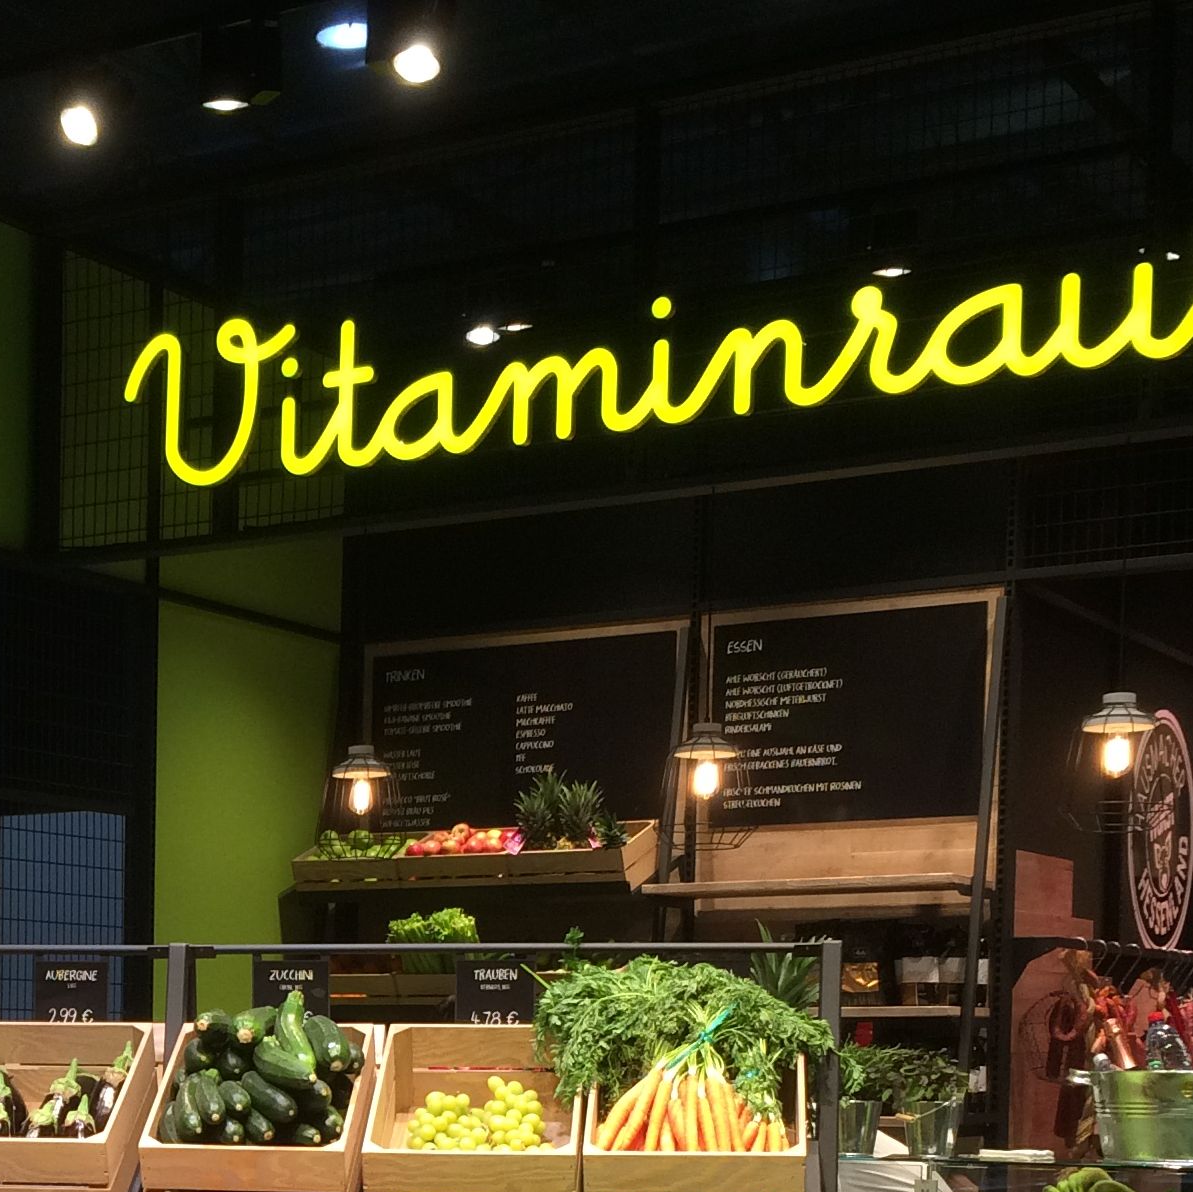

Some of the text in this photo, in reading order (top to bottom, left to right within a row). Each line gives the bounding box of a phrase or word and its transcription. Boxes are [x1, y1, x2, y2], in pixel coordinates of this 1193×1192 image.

[726, 639, 763, 655] ESSEN
[516, 693, 537, 702] KAFFEE
[796, 745, 807, 755] AN
[816, 782, 829, 792] MIT
[45, 969, 99, 982] AUBERGINE
[269, 969, 314, 981] ZUCCHINI
[473, 968, 518, 981] TRAUBEN
[81, 1009, 94, 1022] €
[506, 1010, 519, 1024] €
